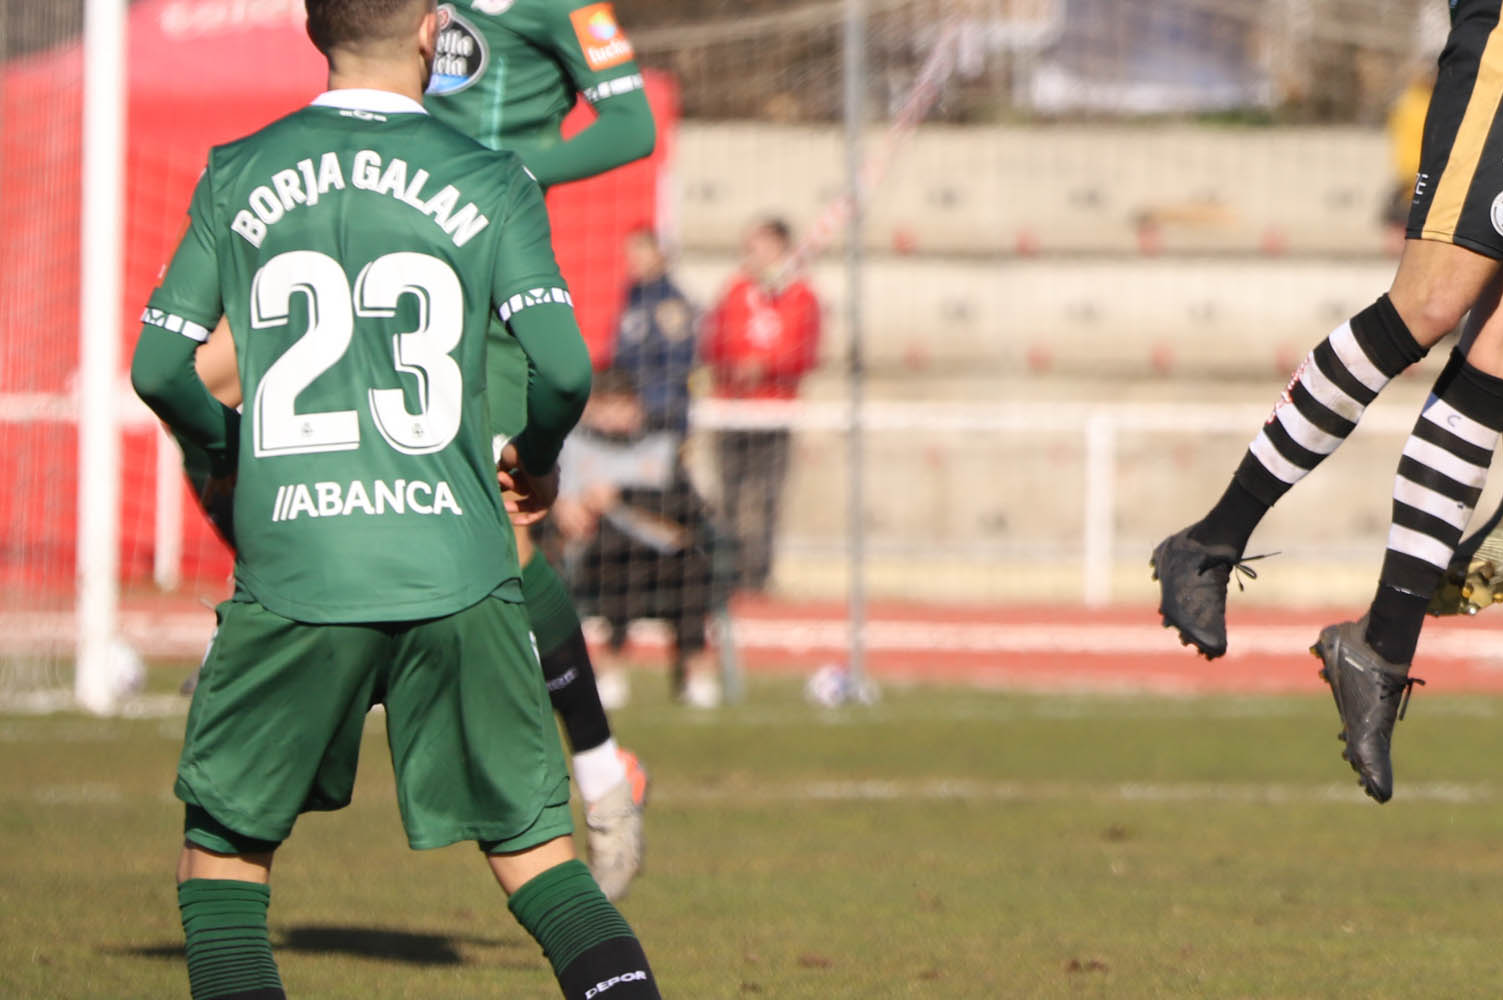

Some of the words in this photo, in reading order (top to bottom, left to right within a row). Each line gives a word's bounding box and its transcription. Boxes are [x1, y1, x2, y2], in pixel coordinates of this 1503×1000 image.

[230, 151, 346, 249] BORJA
[352, 149, 490, 248] GALAN
[250, 250, 464, 458] 23
[584, 970, 648, 1000] DEPOR
